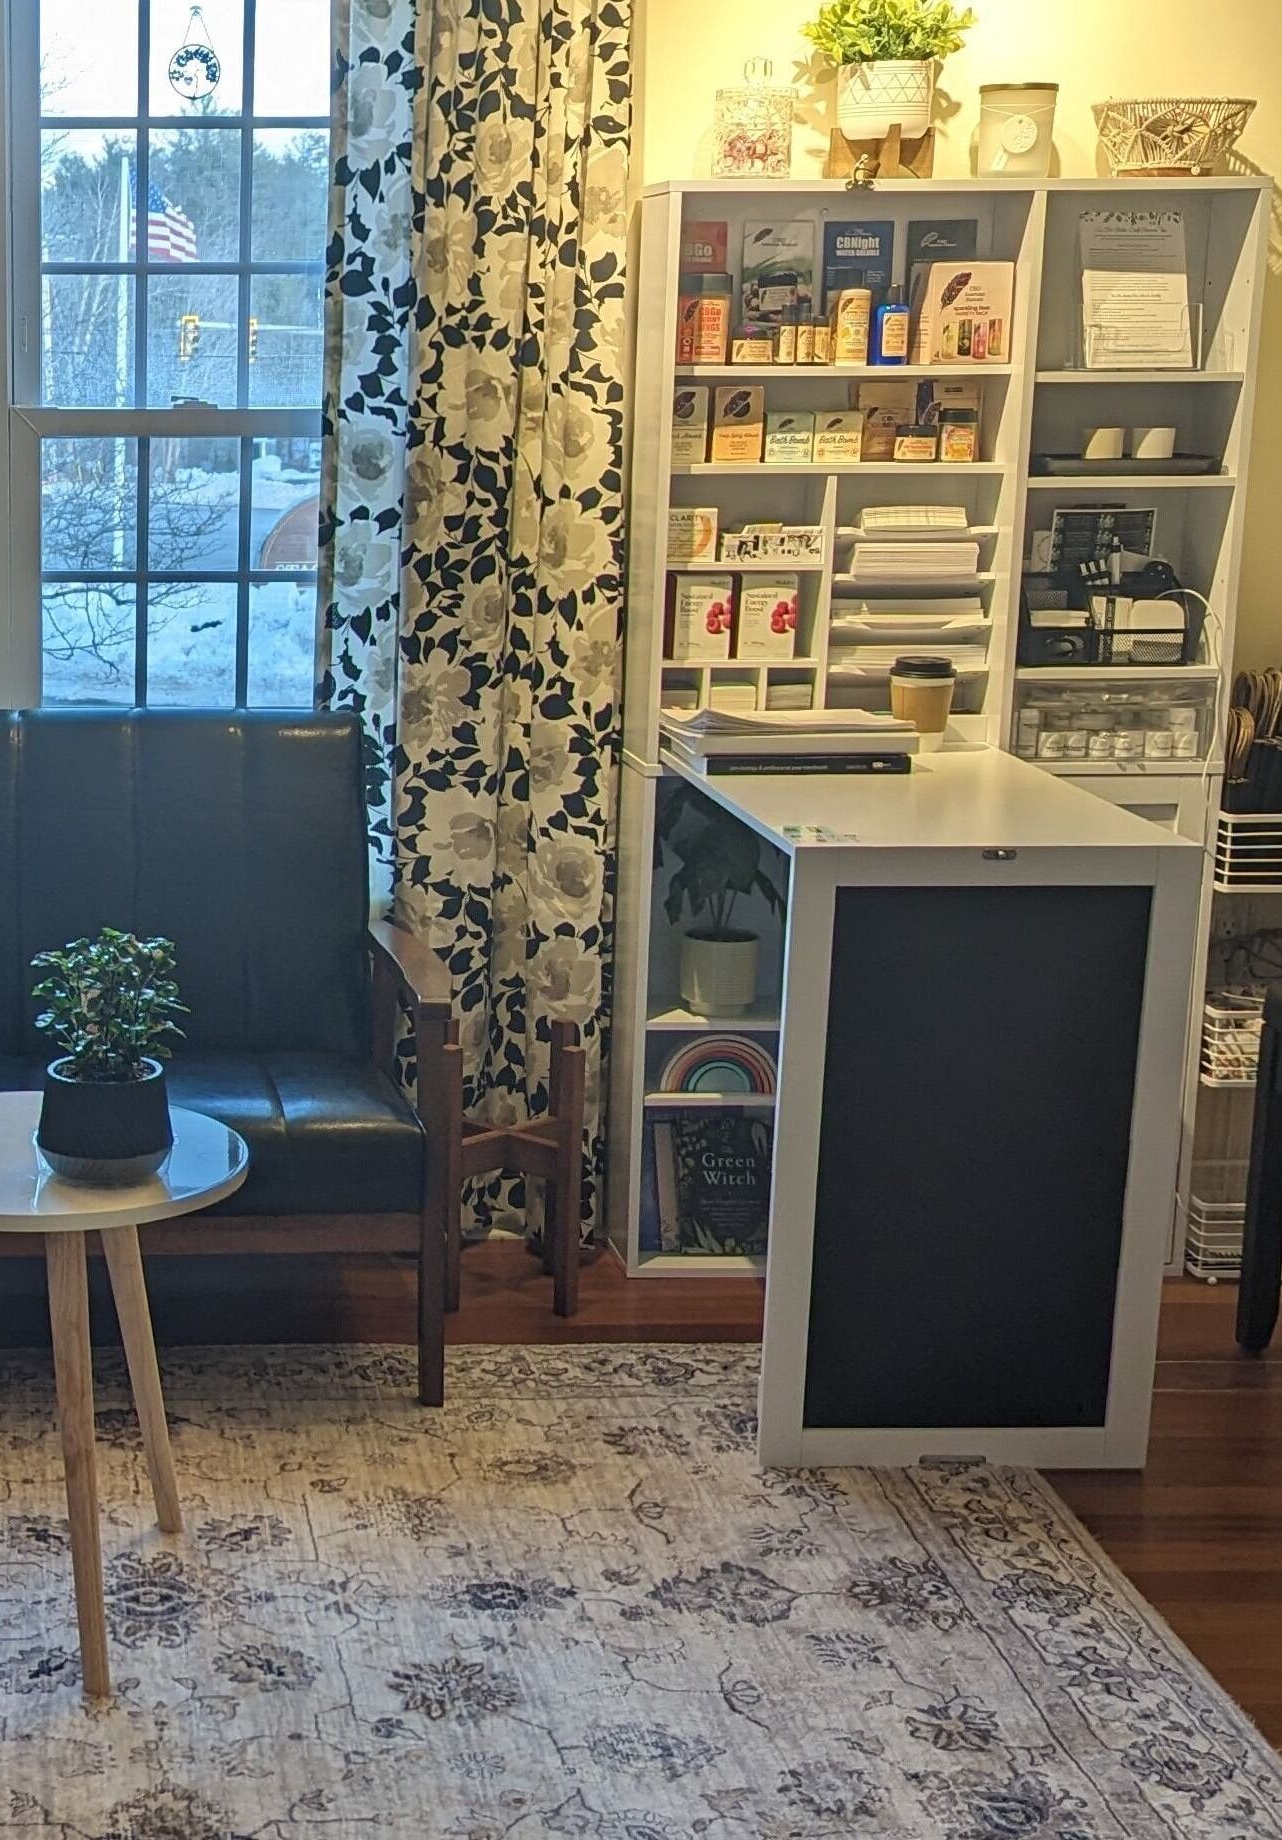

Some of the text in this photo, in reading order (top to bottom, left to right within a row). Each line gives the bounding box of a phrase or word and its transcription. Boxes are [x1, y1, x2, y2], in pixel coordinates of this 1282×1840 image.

[836, 236, 880, 250] CBNight
[769, 434, 788, 445] Bath
[788, 434, 811, 445] Bomb
[819, 434, 860, 444] Bath Bomb
[701, 1152, 756, 1168] Green
[702, 1169, 756, 1185] Witch
